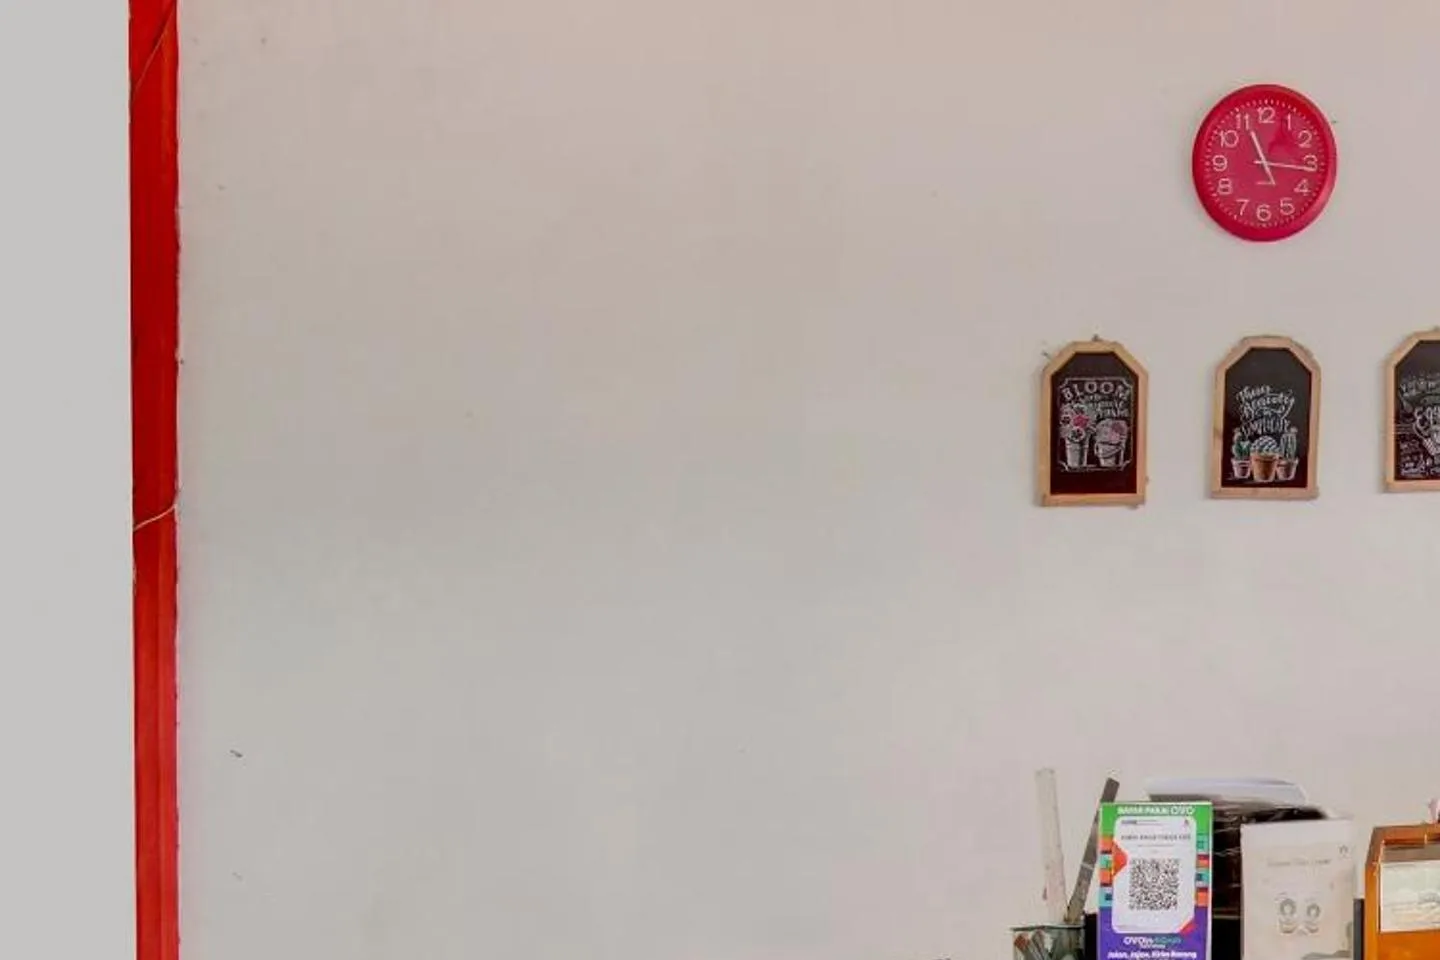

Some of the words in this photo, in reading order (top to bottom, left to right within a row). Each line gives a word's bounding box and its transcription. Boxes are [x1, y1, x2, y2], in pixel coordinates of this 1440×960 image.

[1236, 113, 1250, 130] 11
[1257, 106, 1276, 124] 12
[1286, 113, 1292, 131] 1
[1219, 129, 1239, 148] 10
[1299, 130, 1313, 149] 2
[1212, 154, 1228, 172] 9
[1303, 154, 1318, 172] 3
[1217, 178, 1233, 195] 8
[1293, 179, 1311, 196] 4
[1235, 199, 1250, 216] 7
[1256, 204, 1272, 222] 6
[1280, 197, 1296, 216] 5
[1170, 806, 1196, 815] OVO
